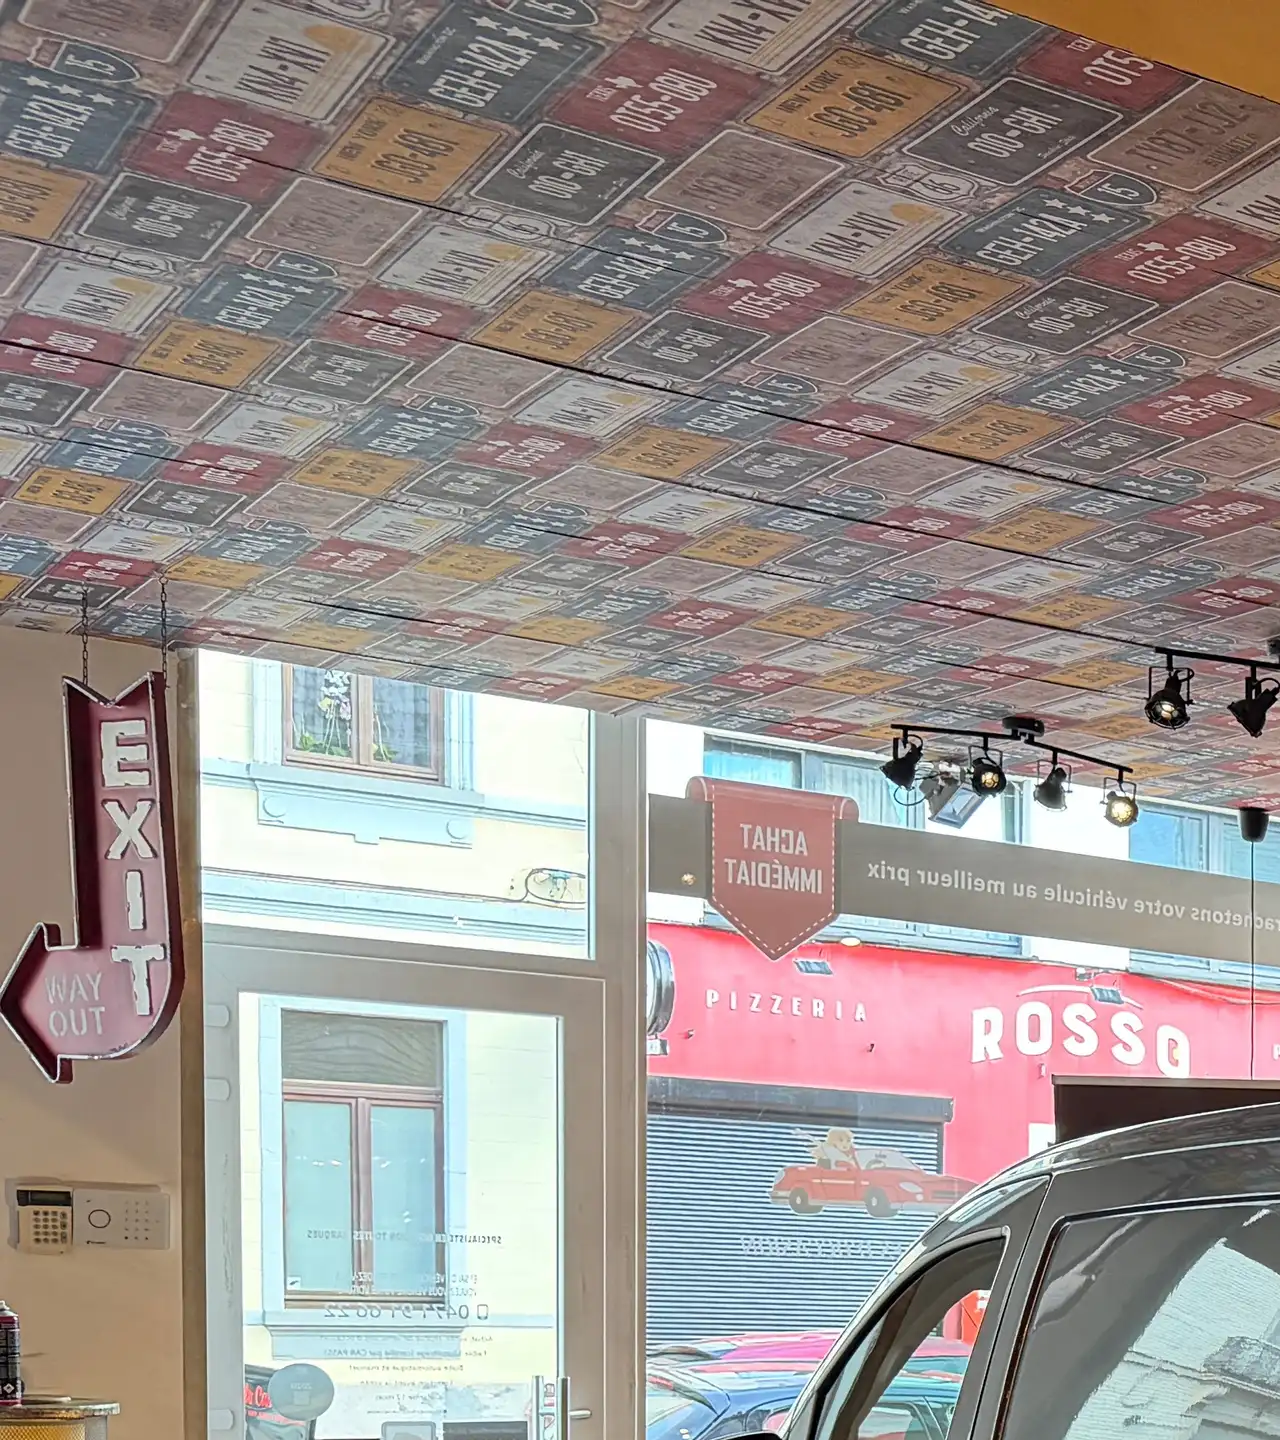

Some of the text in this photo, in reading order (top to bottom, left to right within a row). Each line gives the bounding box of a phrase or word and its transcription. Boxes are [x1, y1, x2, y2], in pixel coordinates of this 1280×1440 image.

[64, 55, 114, 74] 15
[1097, 183, 1139, 199] 15
[666, 222, 708, 237] 15
[276, 260, 317, 273] 15
[1134, 353, 1170, 364] 15
[101, 719, 164, 1016] EXIT
[45, 972, 101, 1004] WAY
[705, 989, 866, 1022] PIZZERIA
[49, 1006, 105, 1036] OUT
[970, 1001, 1191, 1078] ROSSO
